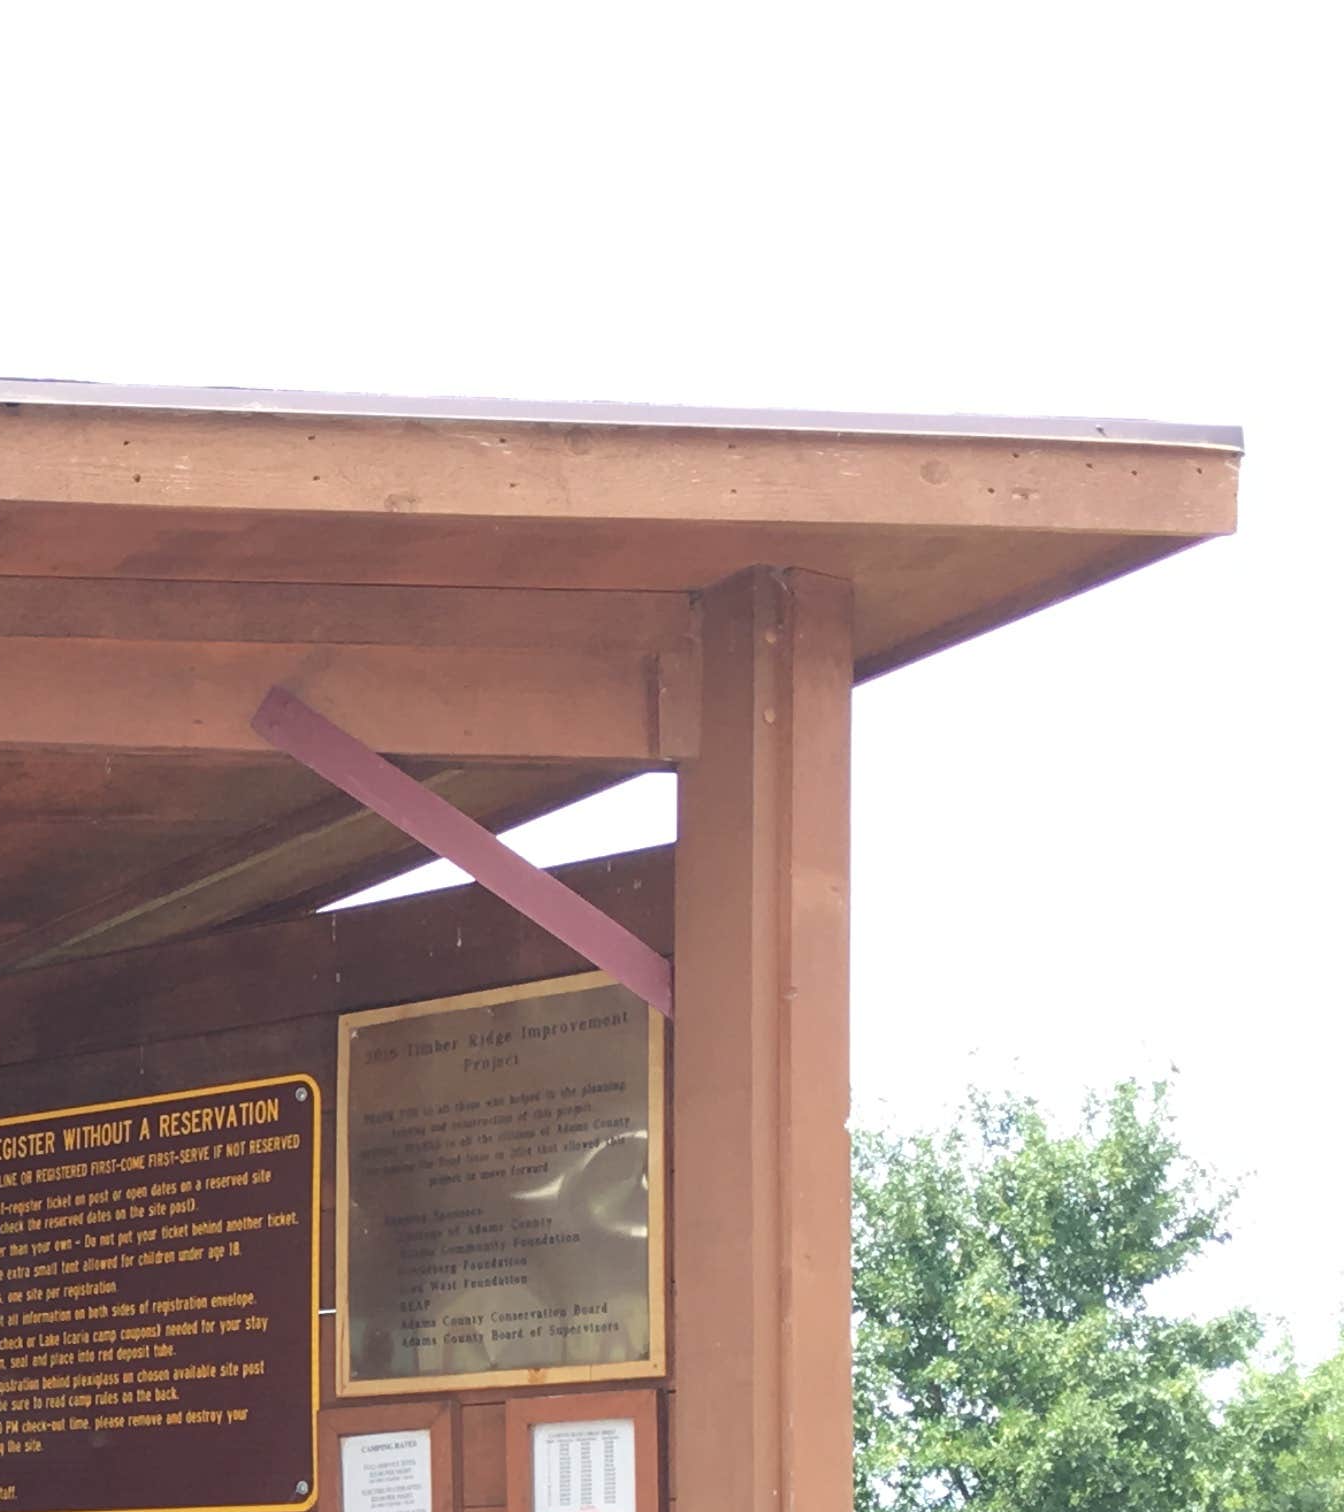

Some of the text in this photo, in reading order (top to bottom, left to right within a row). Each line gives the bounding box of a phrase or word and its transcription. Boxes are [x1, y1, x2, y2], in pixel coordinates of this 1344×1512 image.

[468, 1030, 512, 1048] Ridge
[521, 1011, 628, 1040] Improvement
[464, 1056, 520, 1072] Project
[63, 1120, 132, 1151] WITHOUT
[139, 1118, 150, 1141] A
[159, 1098, 278, 1138] RESERVATION
[90, 1156, 145, 1176] FIRST-COME
[148, 1147, 209, 1168] FIRST-SERVE
[213, 1145, 223, 1159] IF
[226, 1142, 245, 1158] NOT
[248, 1134, 300, 1154] RESERVED
[150, 1182, 177, 1197] dates
[204, 1173, 248, 1190] reserved
[251, 1170, 271, 1184] site
[244, 1316, 268, 1333] stay
[219, 1363, 238, 1377] site
[242, 1361, 264, 1378] post
[5, 1421, 19, 1434] PM
